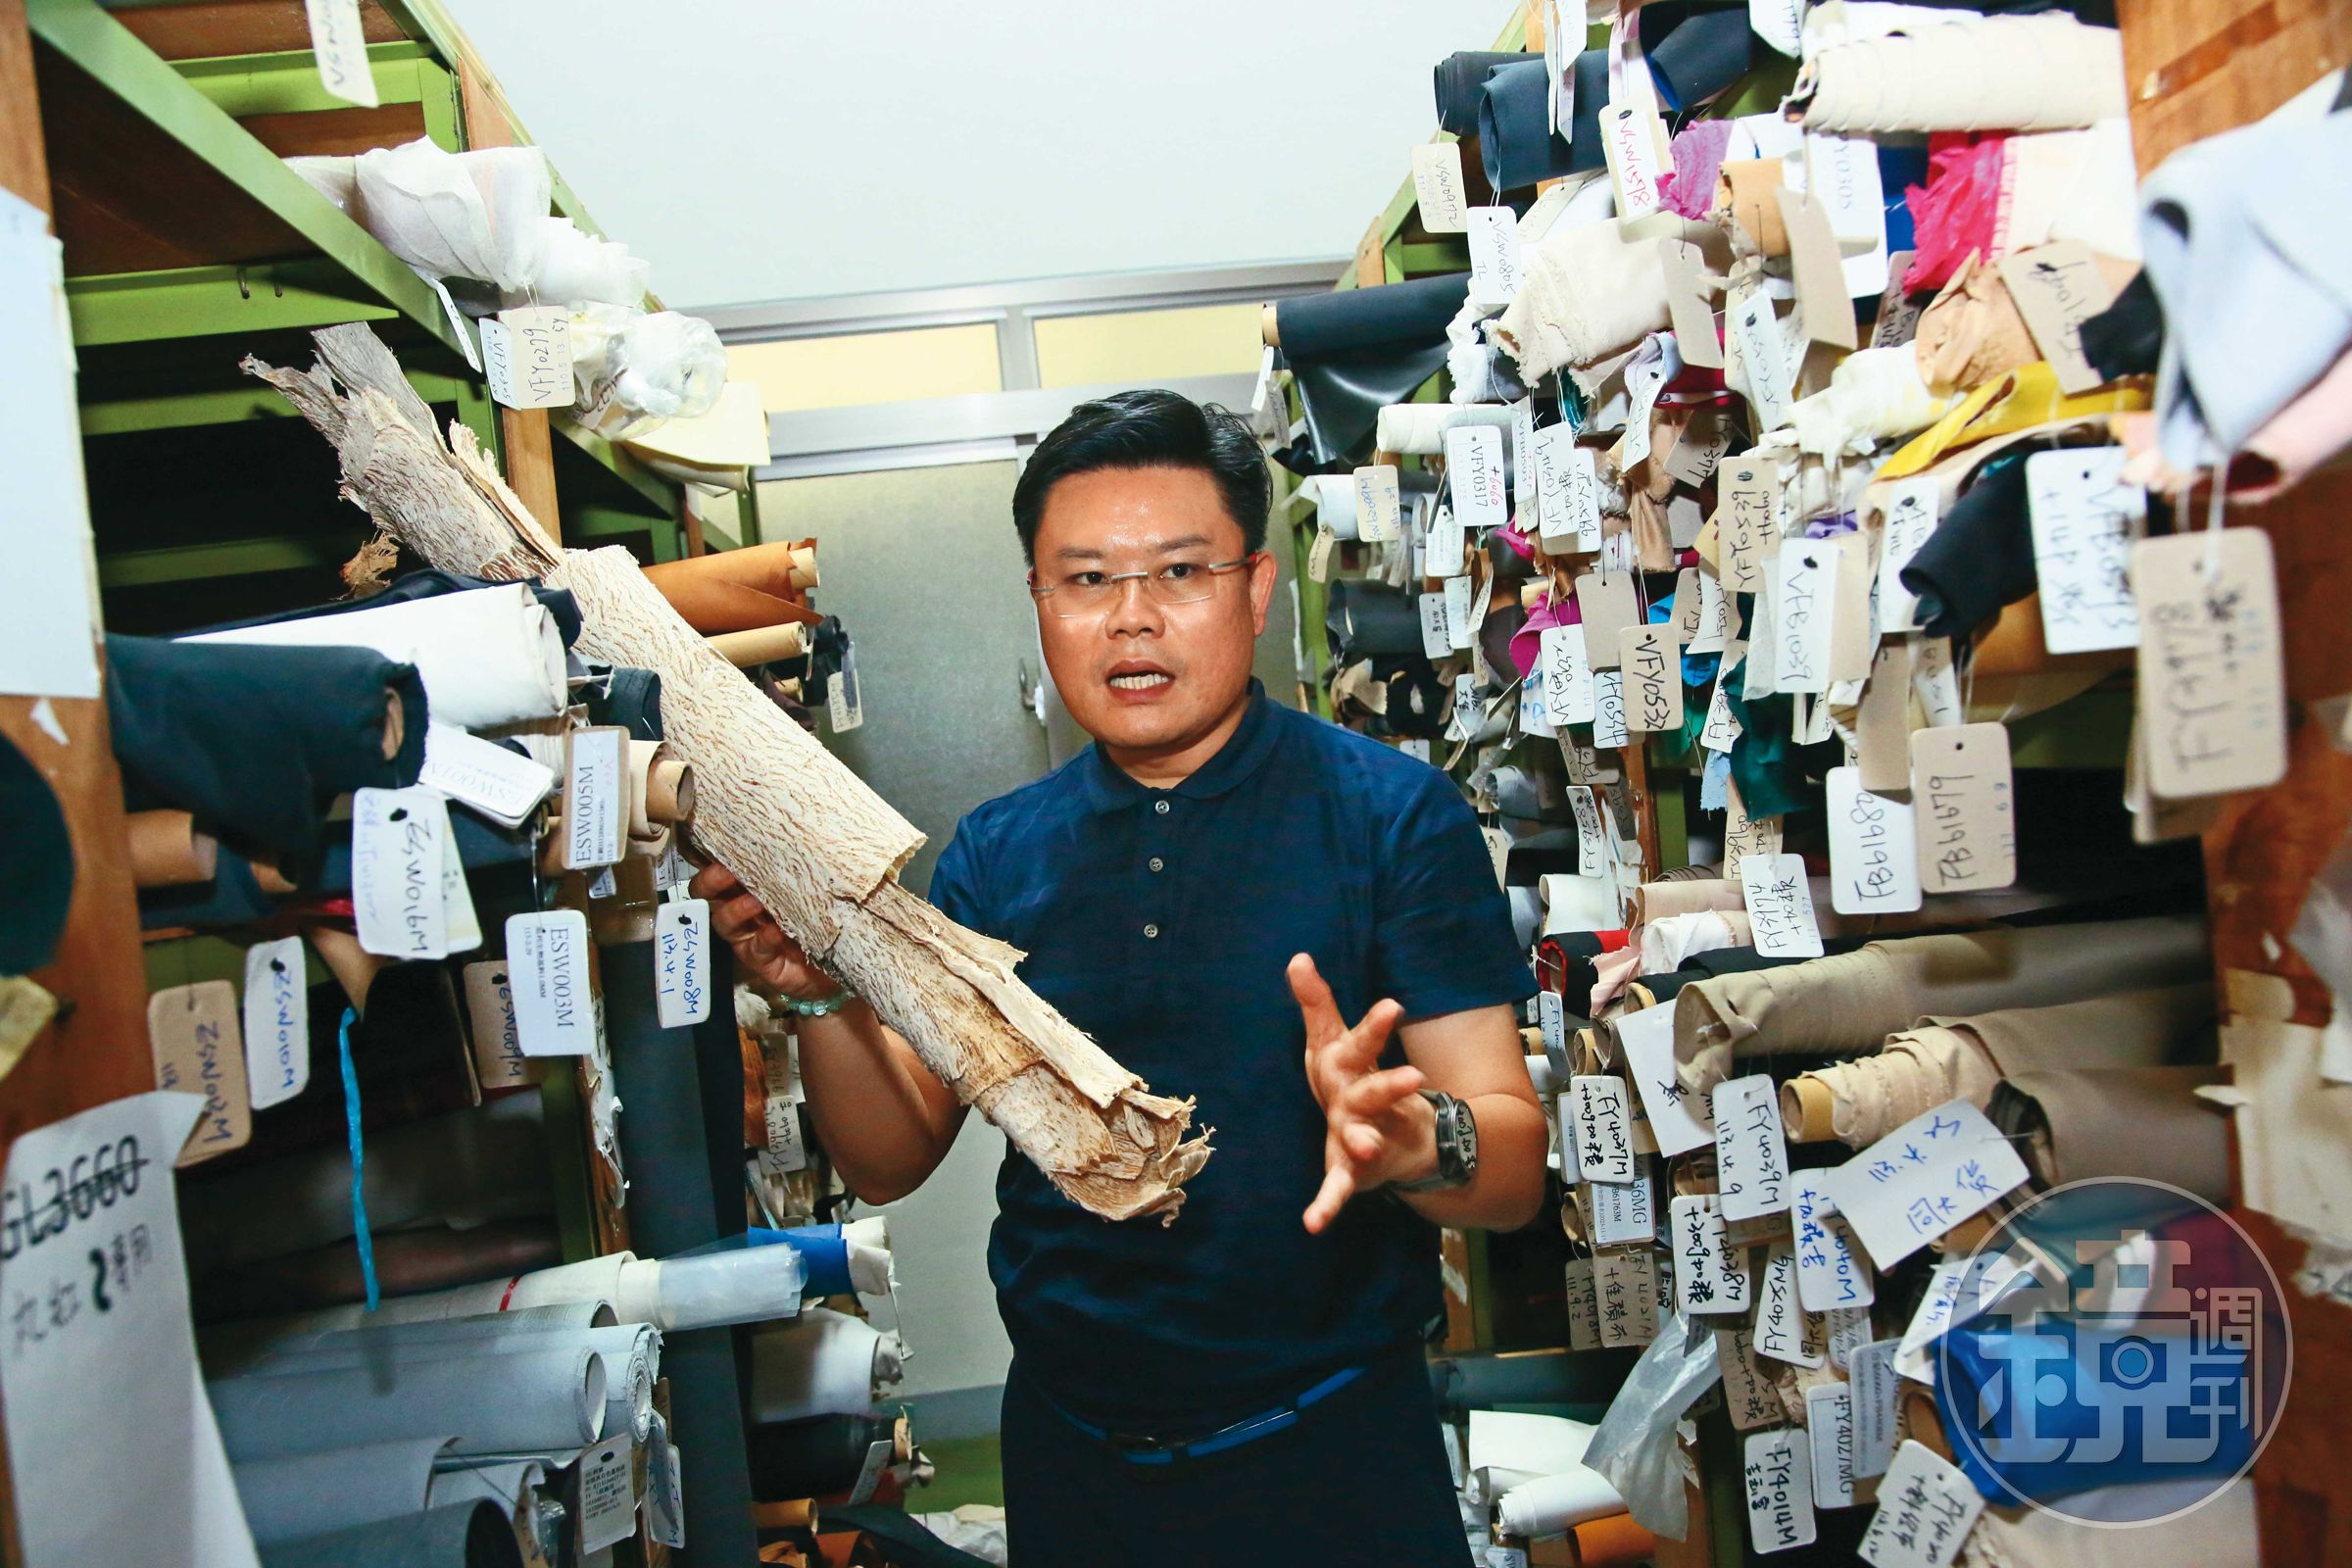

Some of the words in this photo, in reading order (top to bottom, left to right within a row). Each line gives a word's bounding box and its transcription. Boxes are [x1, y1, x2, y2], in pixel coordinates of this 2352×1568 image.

[1470, 445, 1489, 508] VFY0317
[575, 763, 595, 864] ESW005M
[1747, 880, 1788, 951] FY3974
[550, 926, 576, 1028] ESW003M
[1595, 1091, 1630, 1176] FY4037M
[1745, 1099, 1784, 1205] FY4039M
[1765, 1446, 1800, 1546] FY4014M
